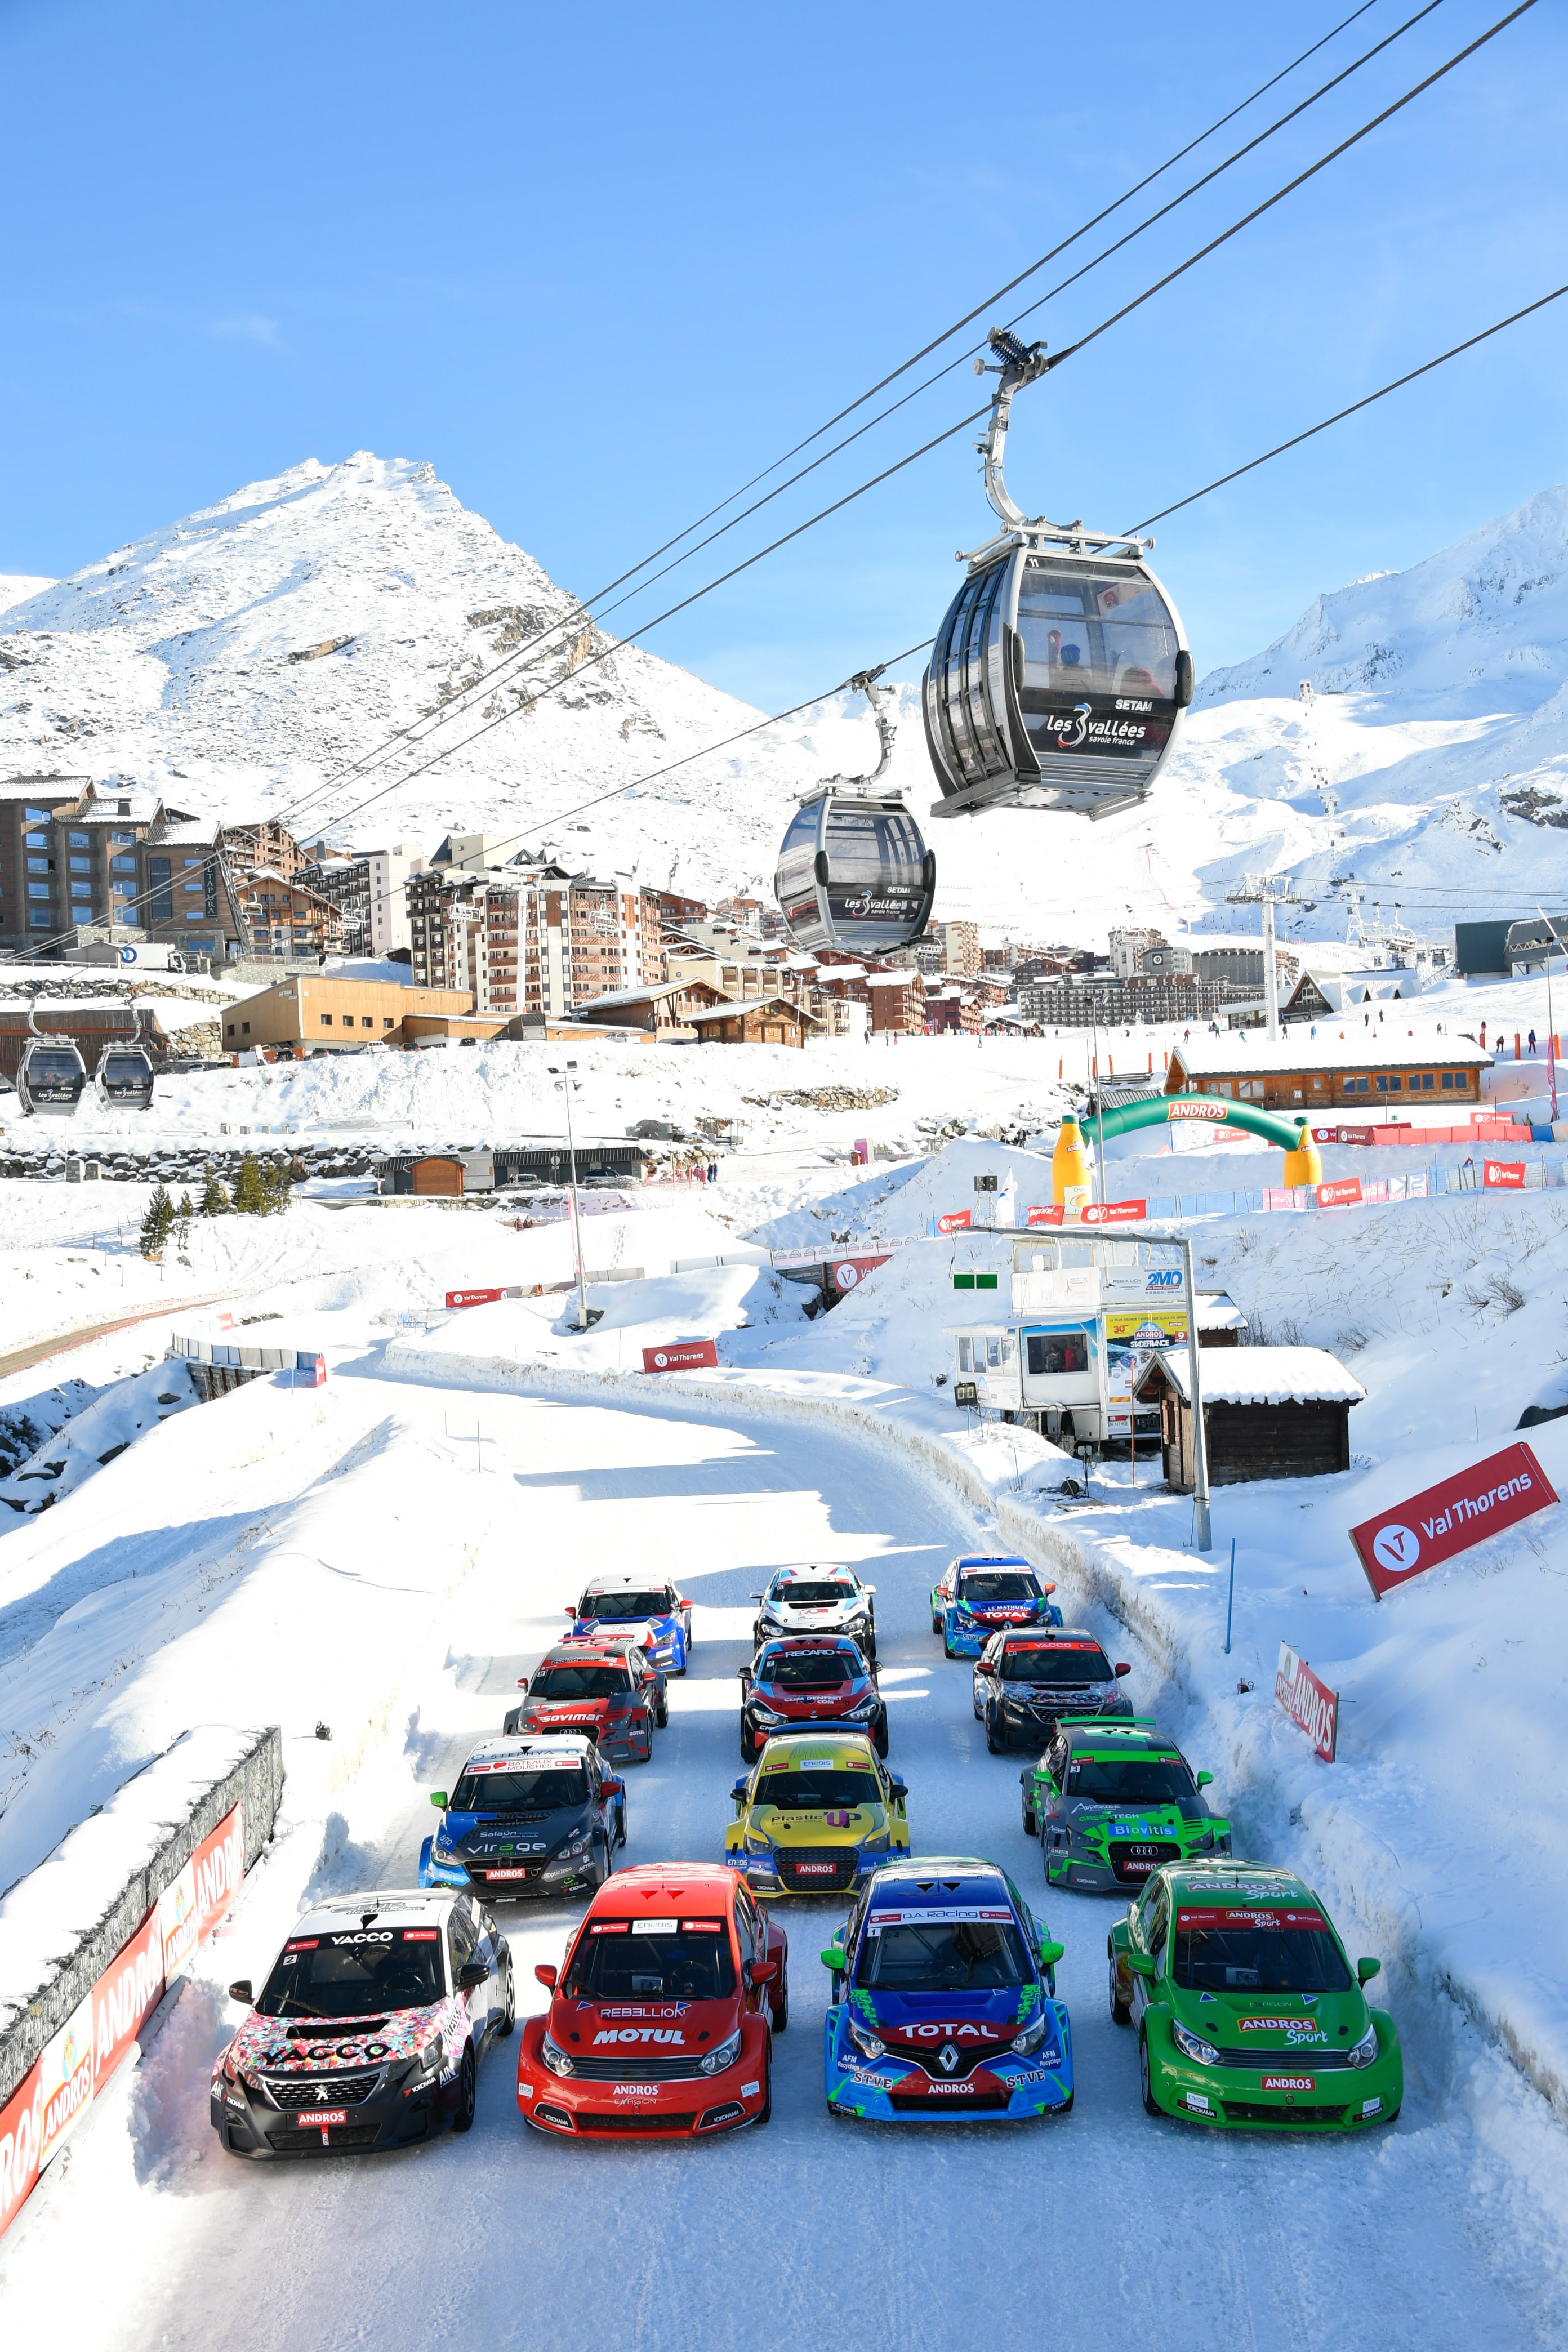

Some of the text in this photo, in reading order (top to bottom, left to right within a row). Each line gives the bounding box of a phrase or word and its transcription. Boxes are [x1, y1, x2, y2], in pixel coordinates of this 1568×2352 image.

[1029, 558, 1039, 568] 11
[1116, 699, 1153, 712] SETAM
[1046, 715, 1072, 732] Les
[1089, 720, 1146, 738] vallées
[1088, 736, 1135, 746] savoie france
[206, 859, 215, 914] ALTAPURA
[845, 898, 860, 908] Les
[871, 899, 907, 910] vallées
[1171, 1103, 1224, 1120] ANDROS
[1148, 1271, 1182, 1286] 2MO
[1178, 1331, 1184, 1340] 9
[679, 1352, 704, 1361] Thorens
[1420, 1473, 1532, 1539] Val Thorens
[785, 1649, 835, 1658] RECARO
[1276, 1675, 1293, 1713] ANDROS
[1291, 1673, 1334, 1752] ANDROS
[491, 1750, 555, 1759] STEPHYA
[1115, 1825, 1172, 1835] Biovitis
[197, 1826, 244, 1911] ANDROS
[544, 1866, 572, 1879] Optic2000
[578, 1861, 595, 1872] AFTRAL
[489, 1869, 523, 1878] ANDROS
[1242, 1890, 1298, 1900] Sport
[1252, 1918, 1280, 1928] Sport
[167, 1913, 196, 1965] ANDROS
[331, 1932, 393, 1945] YACCO
[95, 1935, 163, 2077] ANDROS
[899, 2024, 998, 2038] TOTAL
[1242, 2019, 1312, 2030] ANDROS
[592, 2029, 685, 2045] MOTUL
[1284, 2029, 1328, 2046] Sport
[261, 2043, 390, 2065] YACCO
[842, 2055, 857, 2063] AFM
[1042, 2050, 1055, 2059] AFM
[838, 2061, 859, 2072] Recyclage
[1039, 2057, 1061, 2067] Recyclage
[439, 2066, 456, 2085] AIN
[853, 2072, 893, 2090] STVE
[1006, 2070, 1045, 2088] STVE
[412, 2077, 436, 2093] YOKOHAMA
[613, 2084, 659, 2095] ANDROS
[928, 2084, 974, 2094] ANDROS
[1265, 2078, 1312, 2089] ANDROS
[44, 2053, 91, 2145] ANDROS
[227, 2096, 246, 2110] YOKOHAMA
[1188, 2094, 1206, 2104] ENEDIS
[714, 2110, 739, 2123] YOKOHAMA
[1187, 2104, 1215, 2117] YOKOHAMA
[1362, 2106, 1382, 2119] YOKOHAMA
[299, 2112, 344, 2123] ANDROS
[545, 2114, 568, 2126] YOKOHAMA
